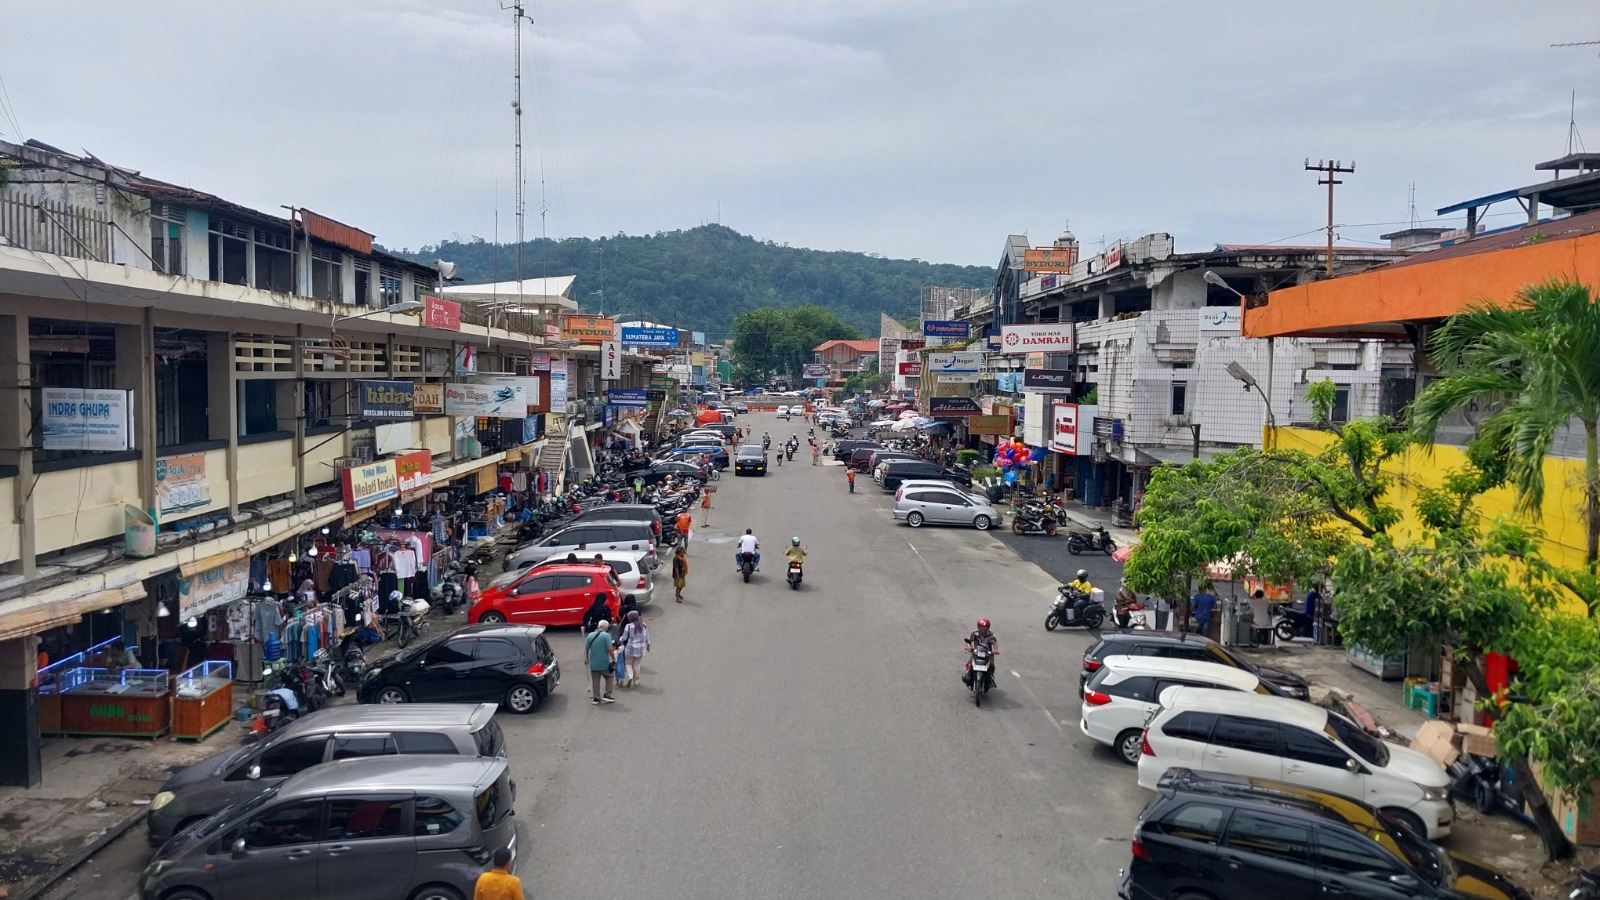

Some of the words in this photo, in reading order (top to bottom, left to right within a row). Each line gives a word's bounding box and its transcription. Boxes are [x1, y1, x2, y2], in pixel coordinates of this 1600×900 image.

[1022, 336, 1069, 345] DAMRAH
[607, 343, 615, 377] ASIA
[48, 402, 76, 416] INDRA
[354, 480, 377, 498] Melati
[378, 475, 396, 492] Indah
